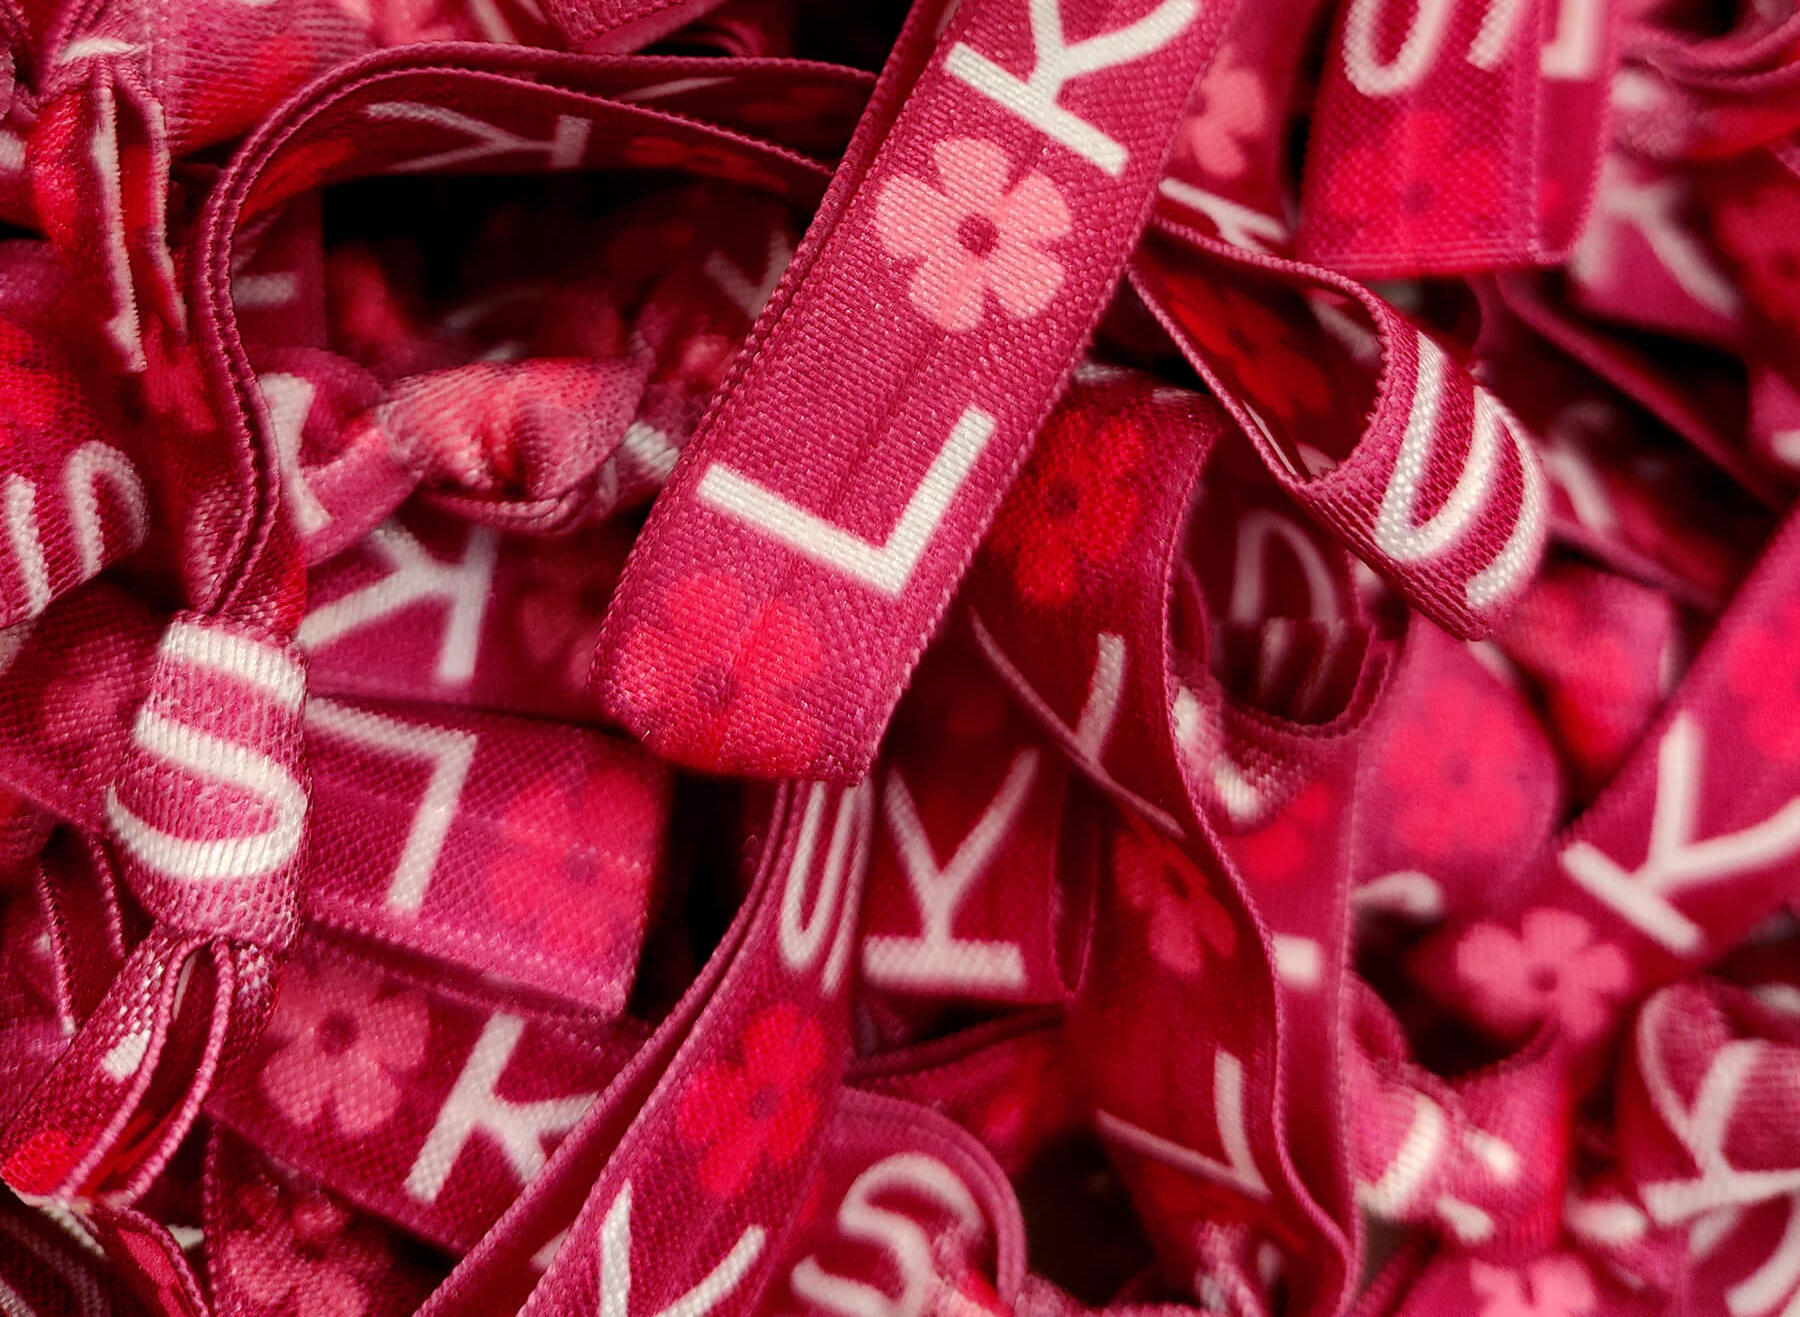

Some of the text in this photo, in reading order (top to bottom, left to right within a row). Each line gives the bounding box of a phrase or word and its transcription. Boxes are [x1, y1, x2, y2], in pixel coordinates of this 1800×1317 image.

[697, 403, 997, 599] L
[1372, 329, 1548, 611] S
[105, 618, 306, 880] S
[860, 743, 1028, 987] K
[1557, 697, 1800, 959] K
[403, 1009, 600, 1207] K
